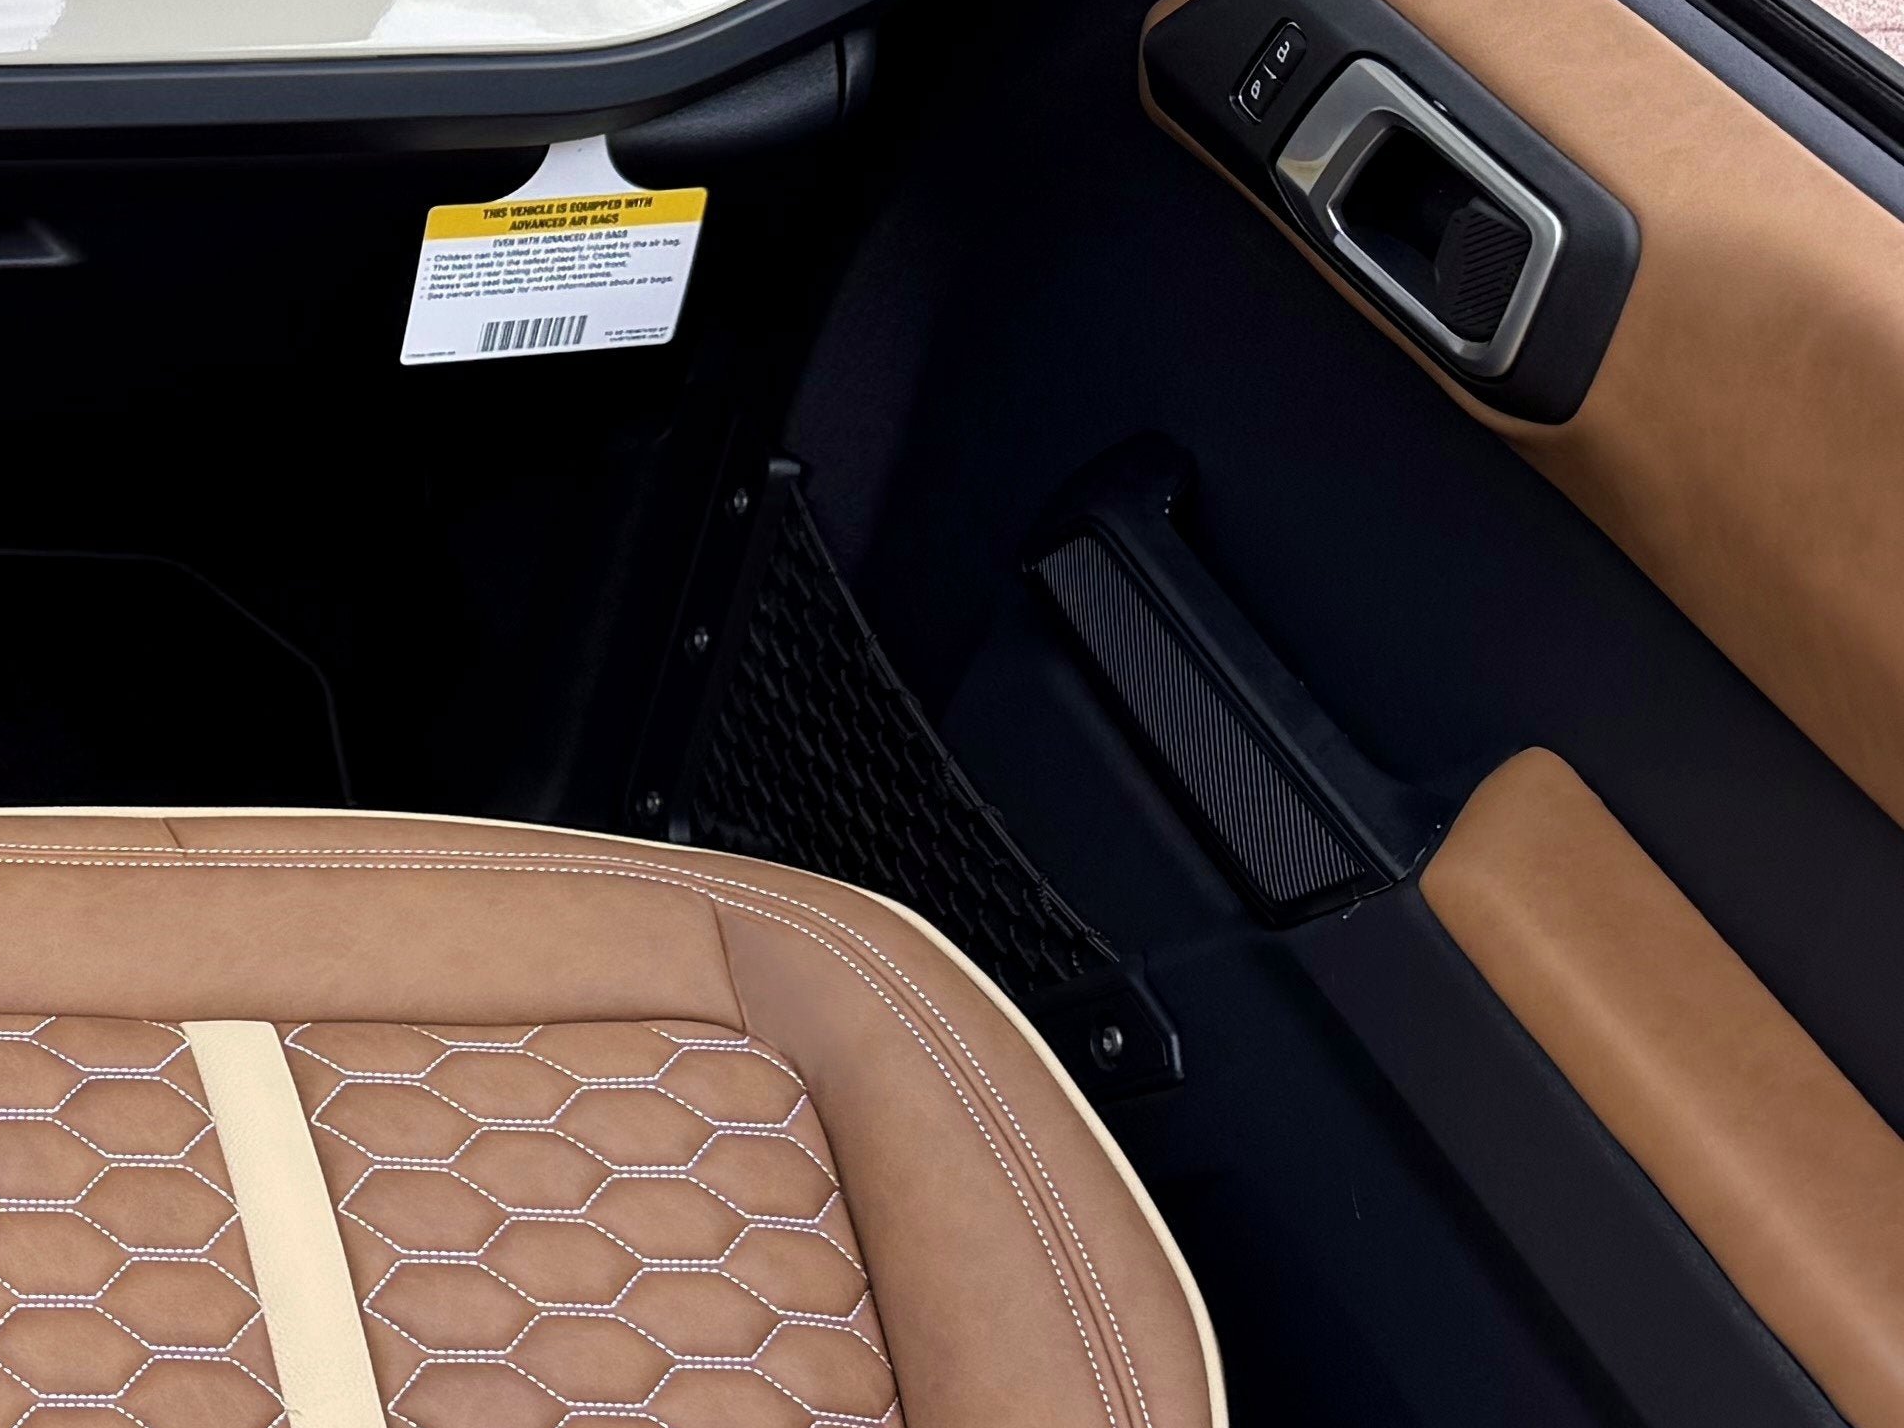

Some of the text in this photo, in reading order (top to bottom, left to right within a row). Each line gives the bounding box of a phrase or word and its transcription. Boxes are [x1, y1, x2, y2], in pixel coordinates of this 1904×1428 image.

[483, 196, 653, 220] THIS VEHICLE IS EQUIPPED WITH
[509, 217, 567, 231] ADVANCED
[569, 215, 588, 226] AIR
